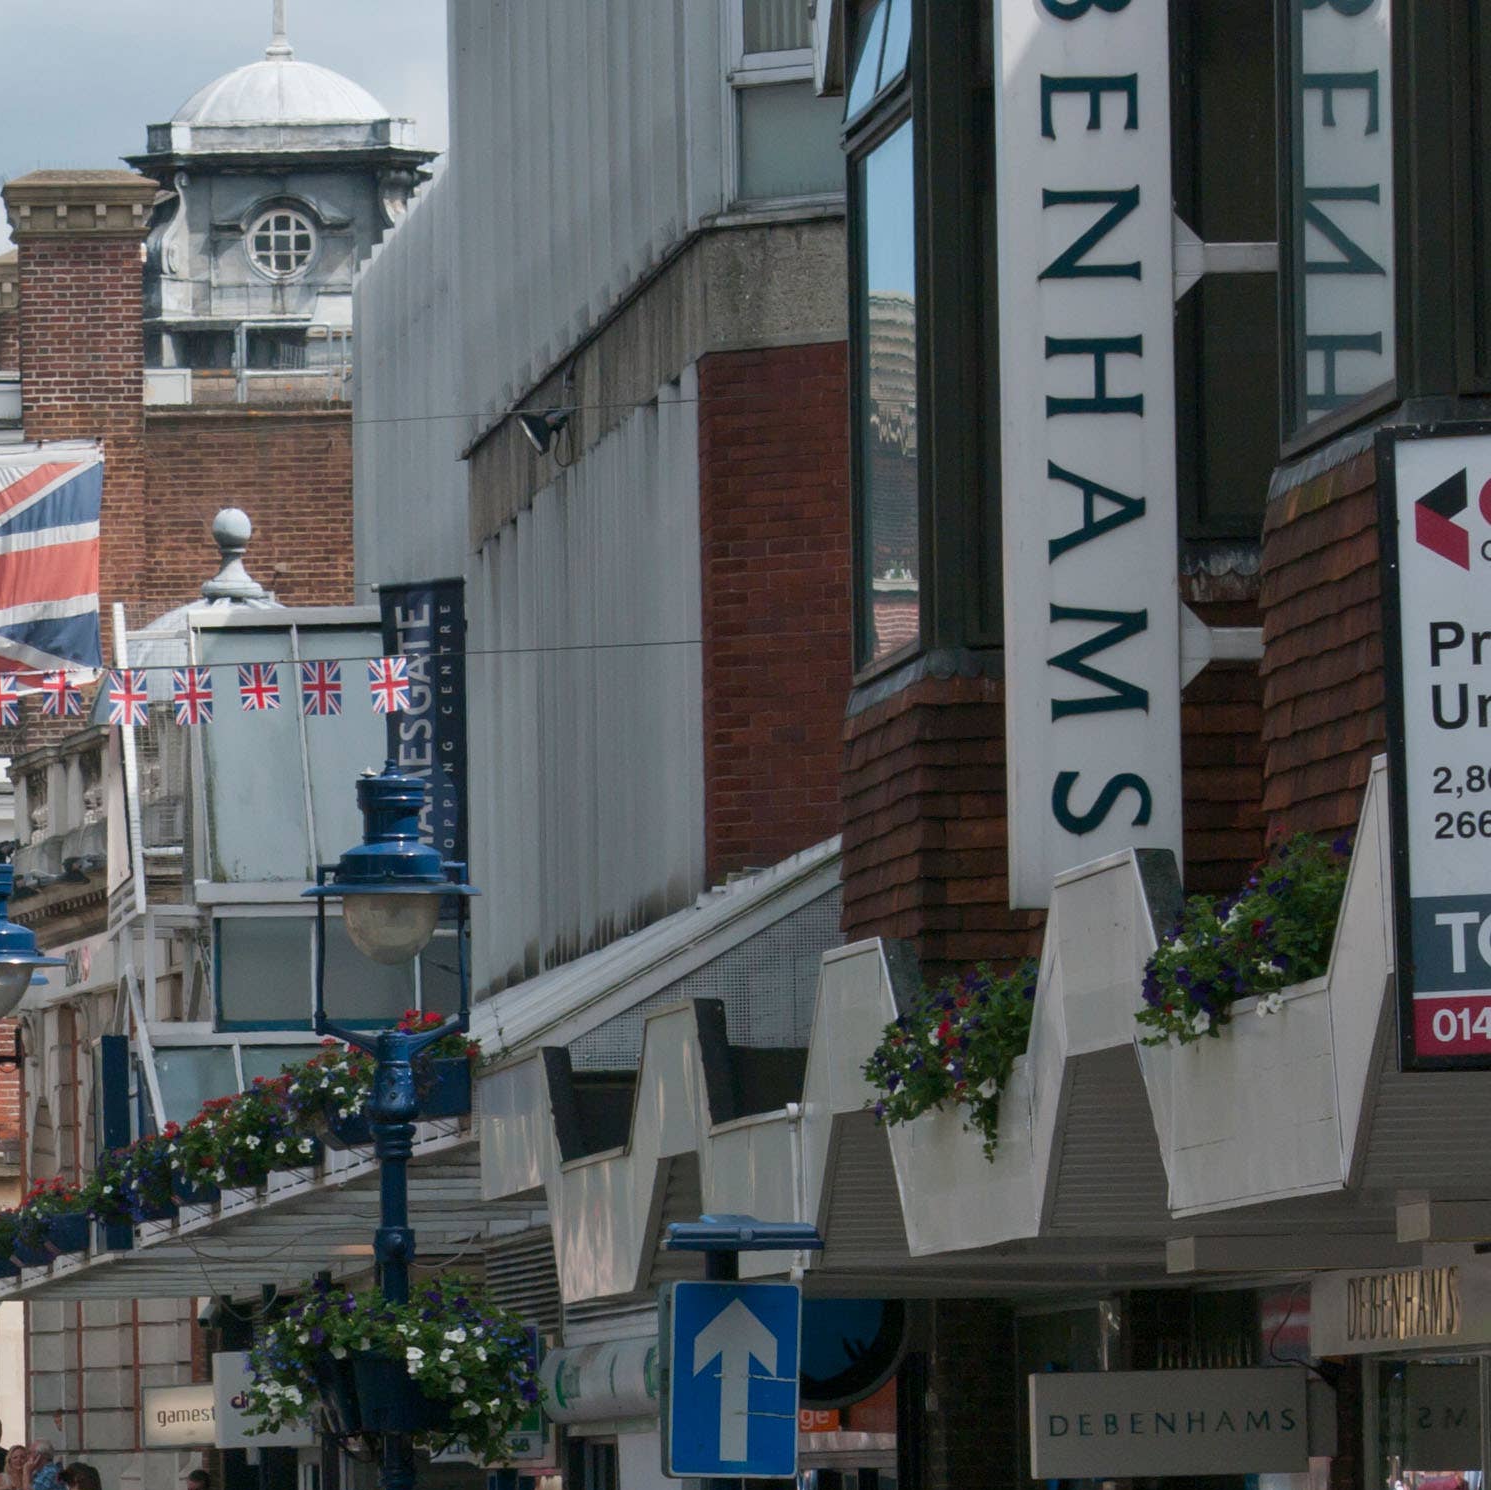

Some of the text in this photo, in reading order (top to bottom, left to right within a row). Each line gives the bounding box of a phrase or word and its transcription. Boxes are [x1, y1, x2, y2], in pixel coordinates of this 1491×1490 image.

[440, 604, 453, 714] CENTRE
[1432, 765, 1491, 800] 2,8
[1434, 911, 1491, 974] T
[1347, 1265, 1461, 1342] DEBENHAMS
[1048, 1408, 1296, 1437] DEBENHAMS
